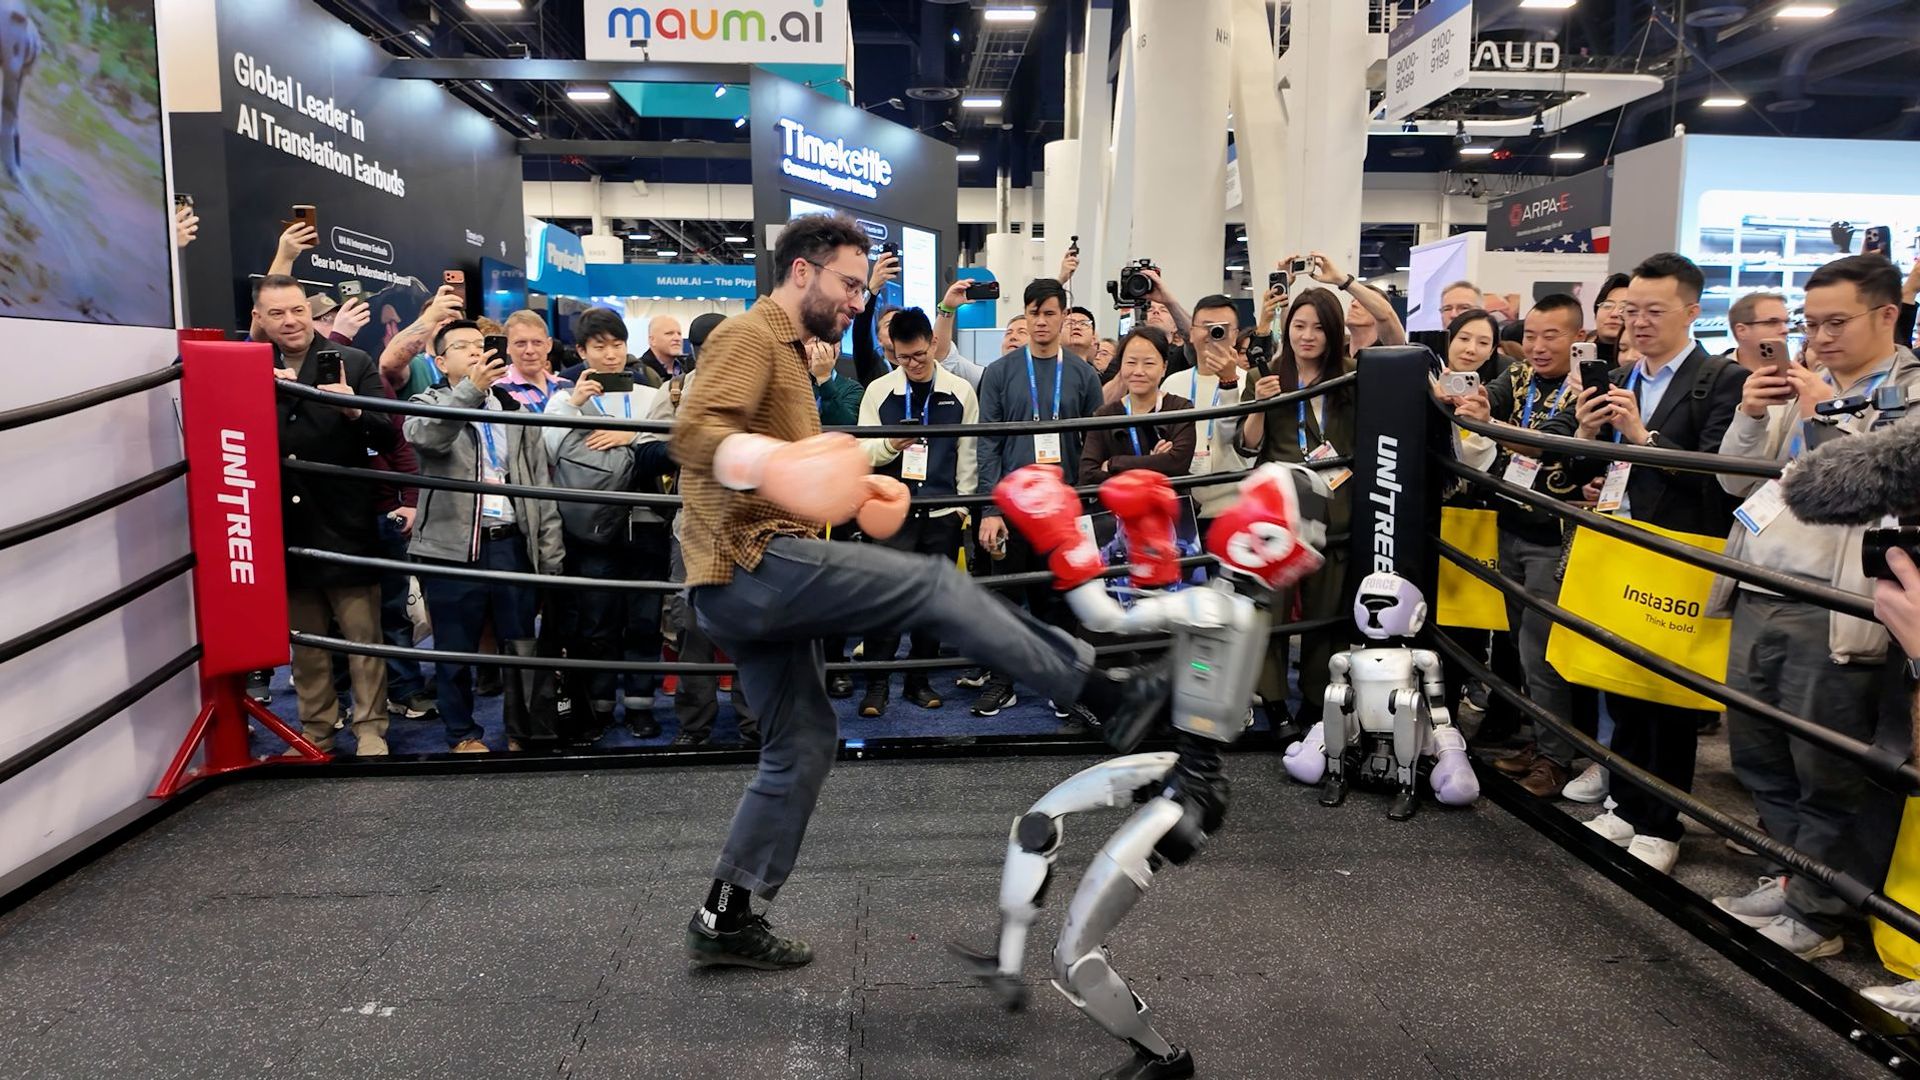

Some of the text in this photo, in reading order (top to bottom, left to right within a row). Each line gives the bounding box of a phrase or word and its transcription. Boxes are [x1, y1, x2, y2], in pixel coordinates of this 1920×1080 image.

[608, 0, 824, 43] maum.ai
[1431, 29, 1455, 54] 9100-
[1396, 52, 1419, 76] 9000-
[1430, 50, 1450, 73] 9199
[233, 52, 365, 142] Global Leader in
[1395, 71, 1415, 94] 9099
[236, 103, 405, 198] AI Translation Earbuds
[780, 118, 892, 186] Timekettle
[1521, 193, 1570, 222] ARPA-E
[311, 253, 328, 269] Clear
[329, 257, 335, 270] in
[356, 263, 387, 282] Understand
[387, 270, 392, 283] in
[656, 277, 701, 286] MAUM.AI
[715, 277, 733, 286] The
[216, 428, 256, 584] UNITREE
[1369, 434, 1403, 574] UNITREE
[1365, 578, 1396, 590] FORCE
[1622, 584, 1700, 618] Insta360
[1645, 613, 1697, 634] Think bold.
